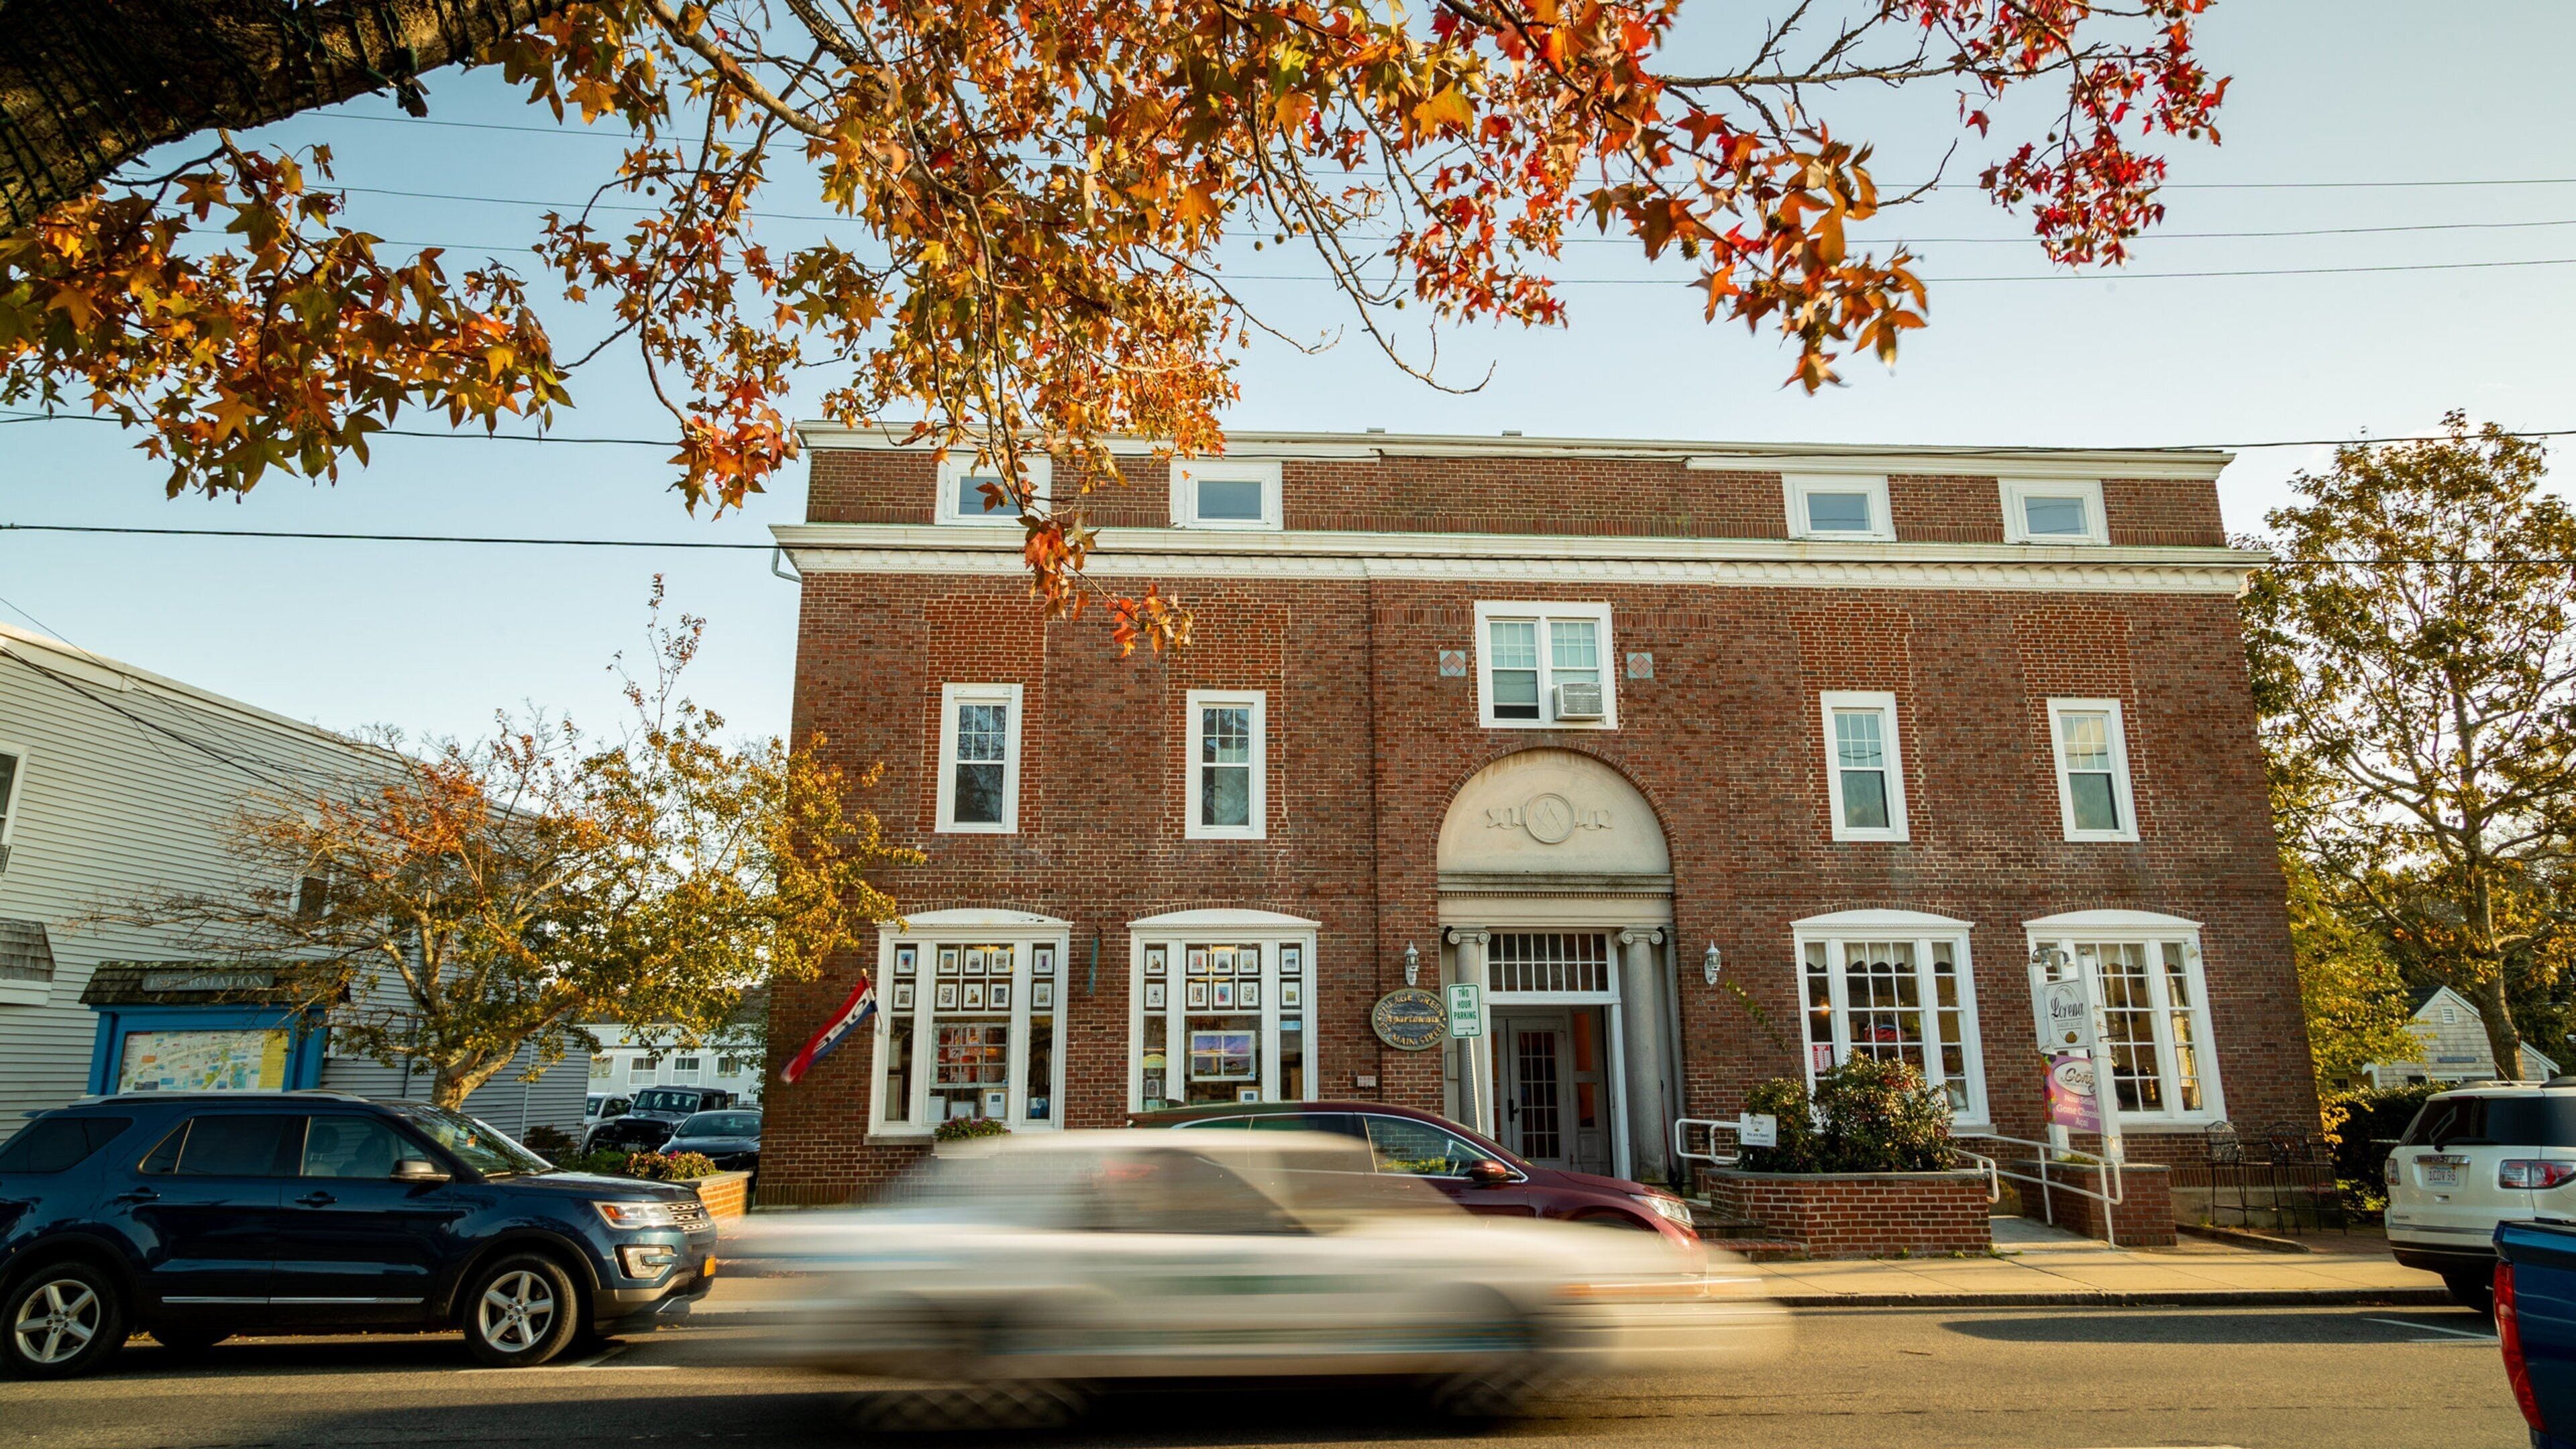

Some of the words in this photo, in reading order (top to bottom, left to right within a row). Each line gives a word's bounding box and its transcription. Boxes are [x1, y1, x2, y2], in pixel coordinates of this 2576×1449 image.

[1458, 989, 1469, 998] TWO
[1416, 994, 1444, 1017] GREEN
[1457, 1000, 1472, 1008] HOUR
[2050, 997, 2084, 1018] Lorena
[1454, 1010, 1477, 1020] PARKING
[1391, 1034, 1415, 1046] MAIN
[1419, 1023, 1446, 1044] STREET
[2056, 1104, 2077, 1115] Gone
